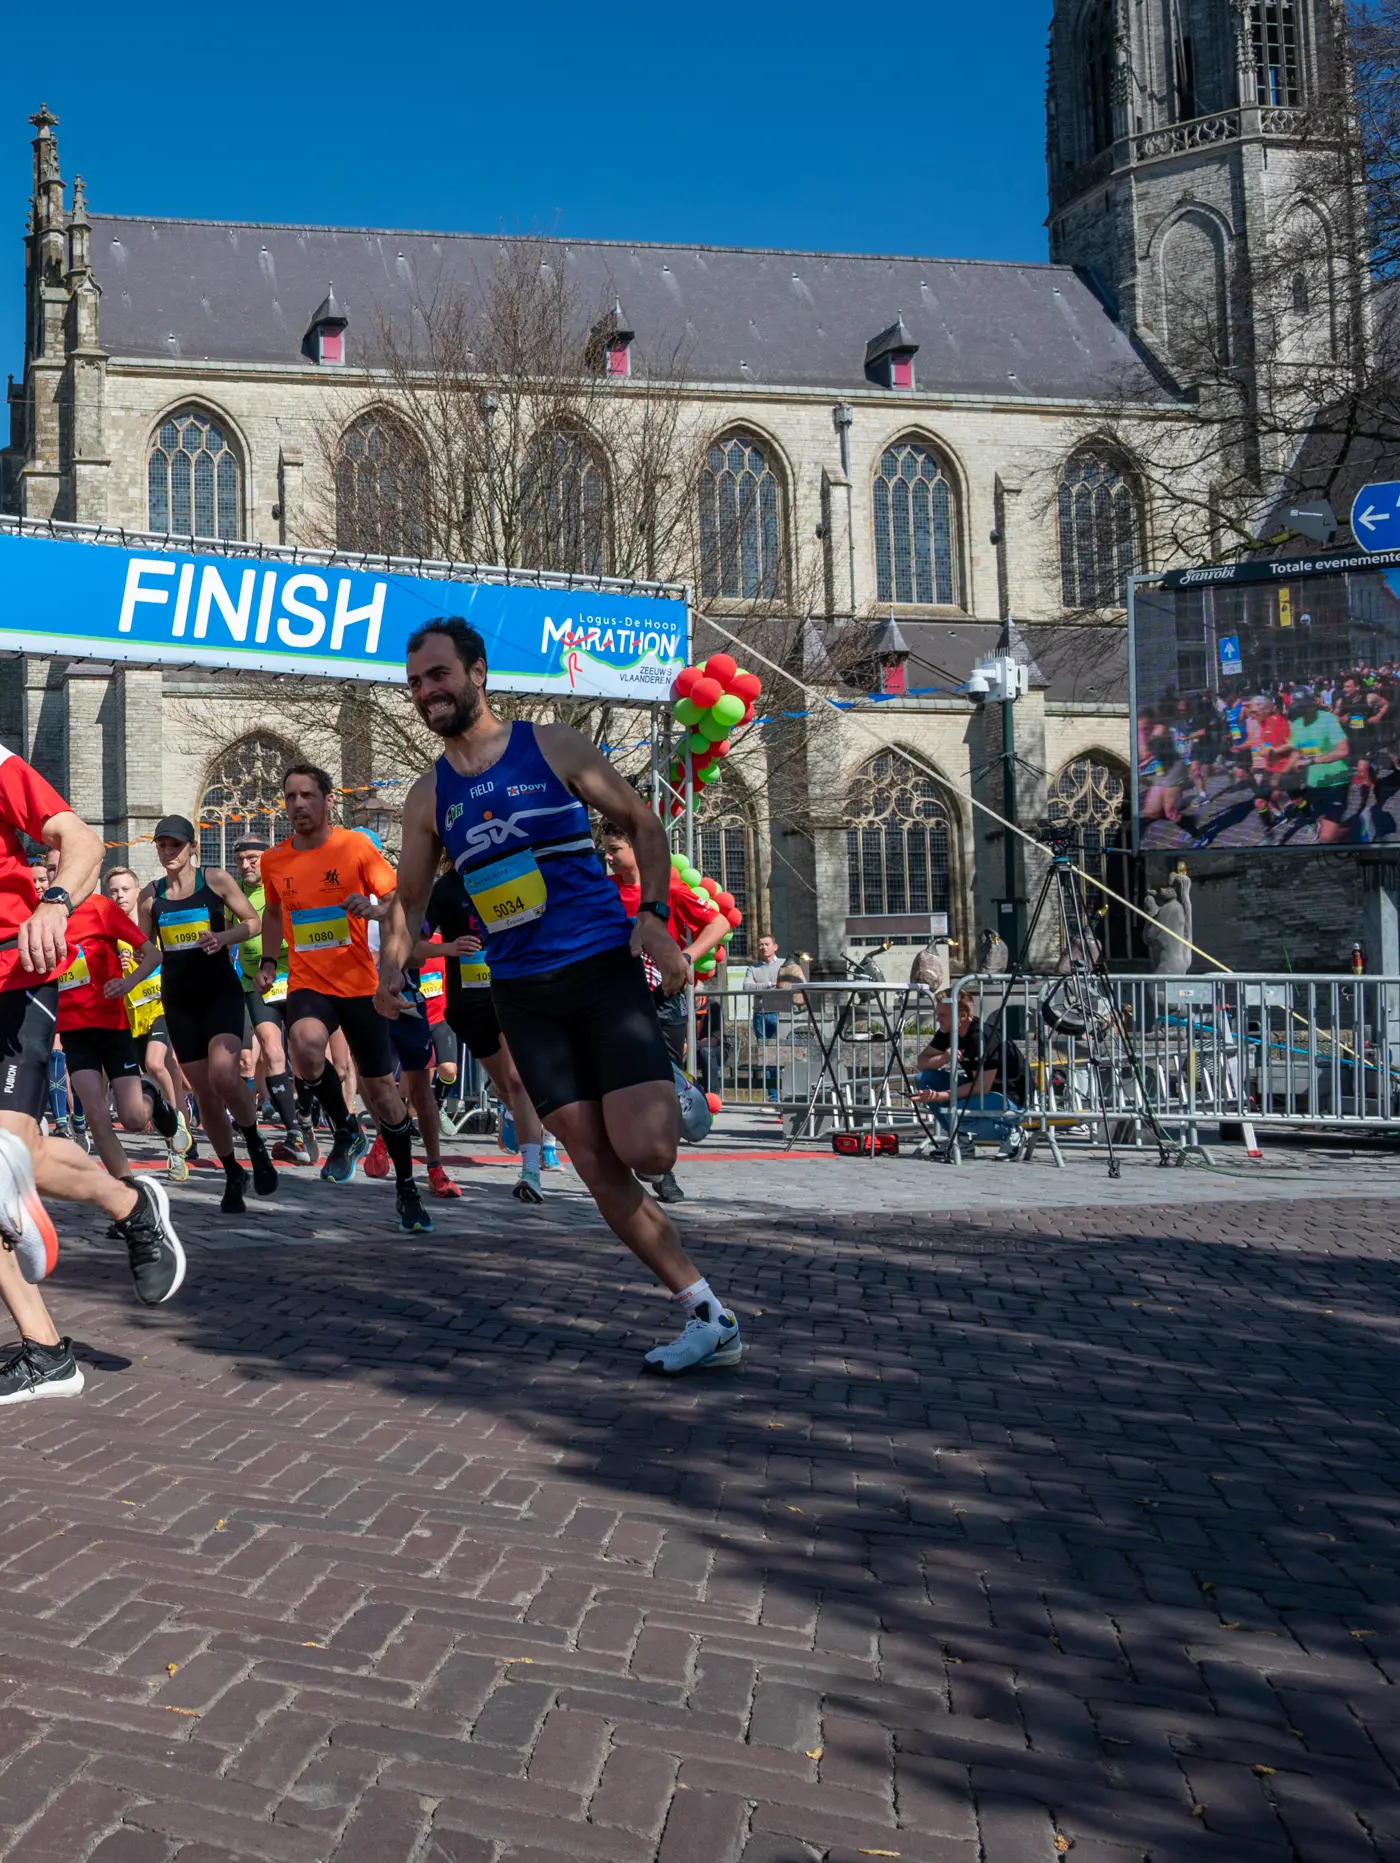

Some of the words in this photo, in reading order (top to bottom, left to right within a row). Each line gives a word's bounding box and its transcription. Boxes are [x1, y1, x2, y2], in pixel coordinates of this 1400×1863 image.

[1270, 560, 1313, 574] Totale
[1315, 552, 1400, 570] evenemente
[118, 557, 387, 653] FINISH
[579, 613, 640, 628] Logus-De
[645, 618, 677, 631] Hoop
[540, 616, 676, 657] MARATHON
[639, 666, 673, 676] ZEEUWS
[619, 673, 672, 685] VLAANDEREN
[519, 783, 547, 792] Dovy
[493, 896, 525, 918] 5034
[174, 932, 197, 943] 1099
[309, 930, 334, 943] 1080
[59, 970, 75, 983] 073
[142, 984, 161, 997] 5076
[4, 1064, 18, 1094] FUSION
